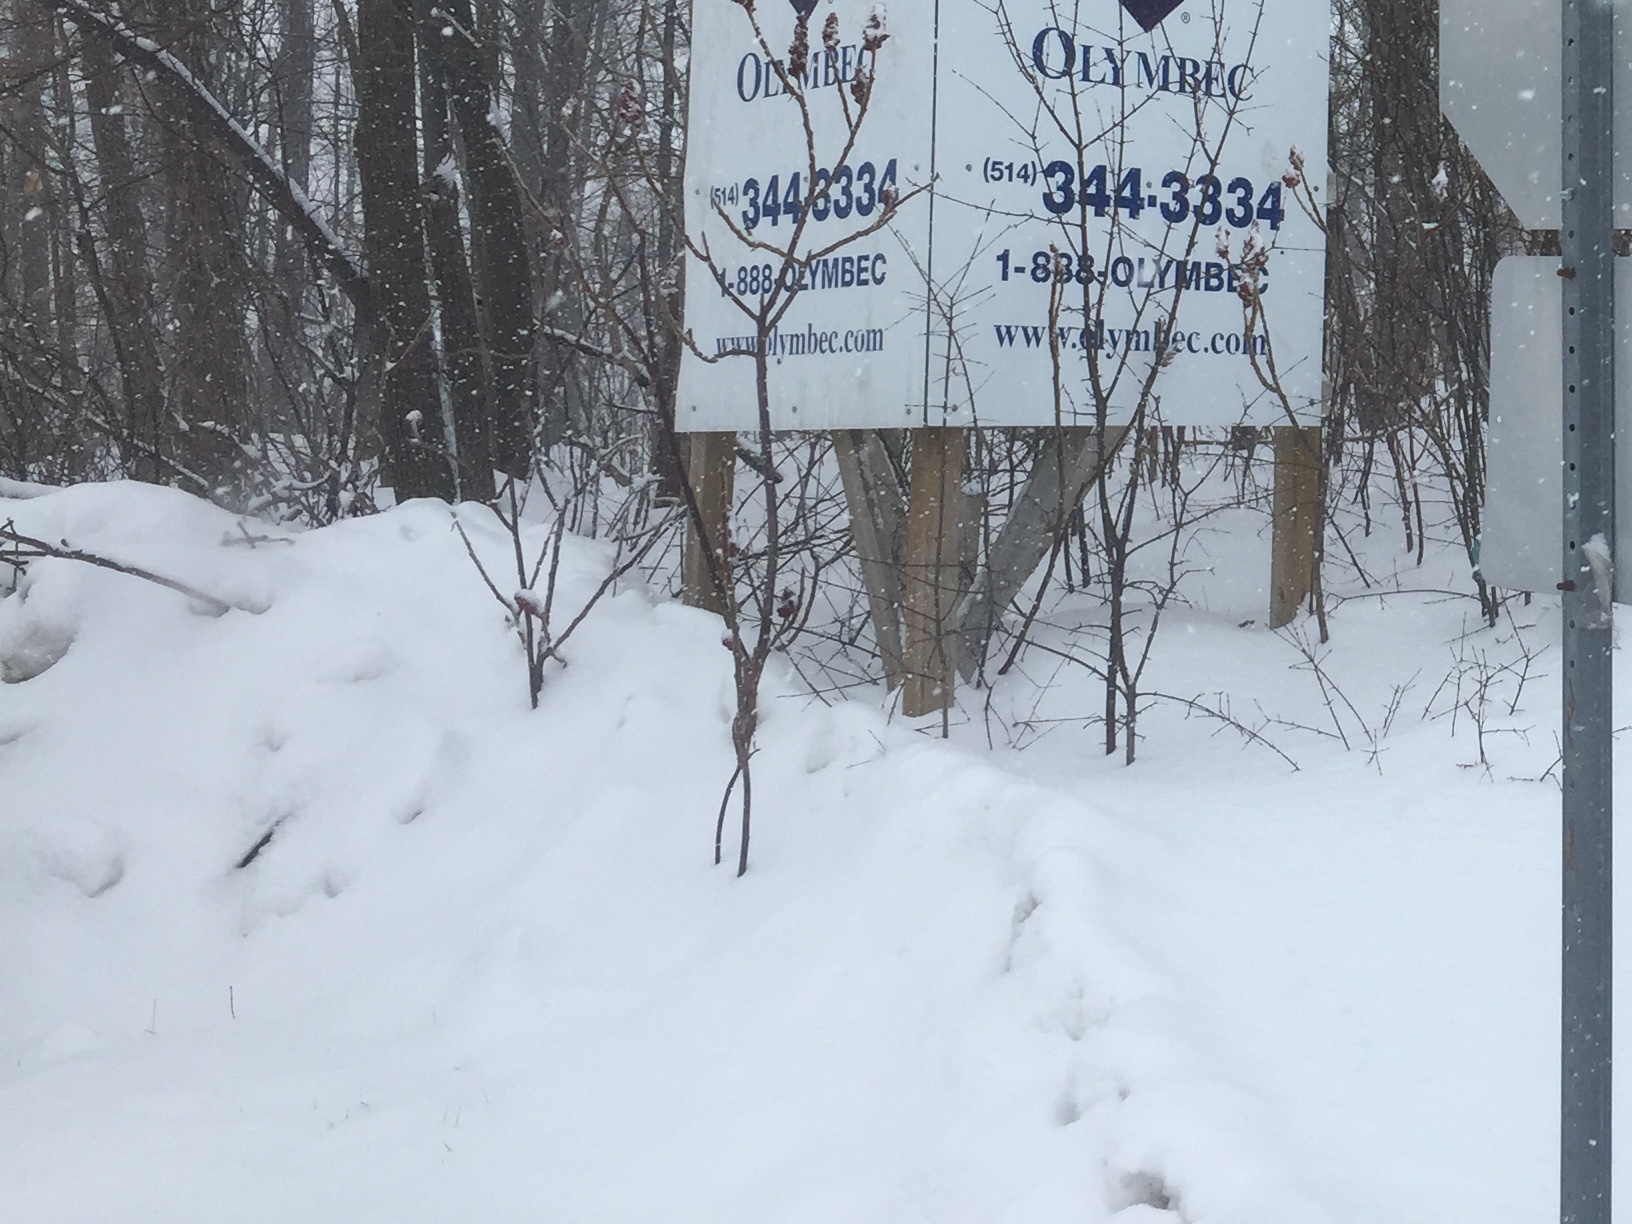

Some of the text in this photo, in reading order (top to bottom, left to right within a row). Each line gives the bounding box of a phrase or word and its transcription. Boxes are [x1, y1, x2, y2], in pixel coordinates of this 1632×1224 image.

[1031, 26, 1256, 102] OLYMBEC
[709, 182, 739, 210] (514)
[983, 156, 1285, 231] (514) 344-3334
[716, 322, 884, 364] wwwolymbec.com
